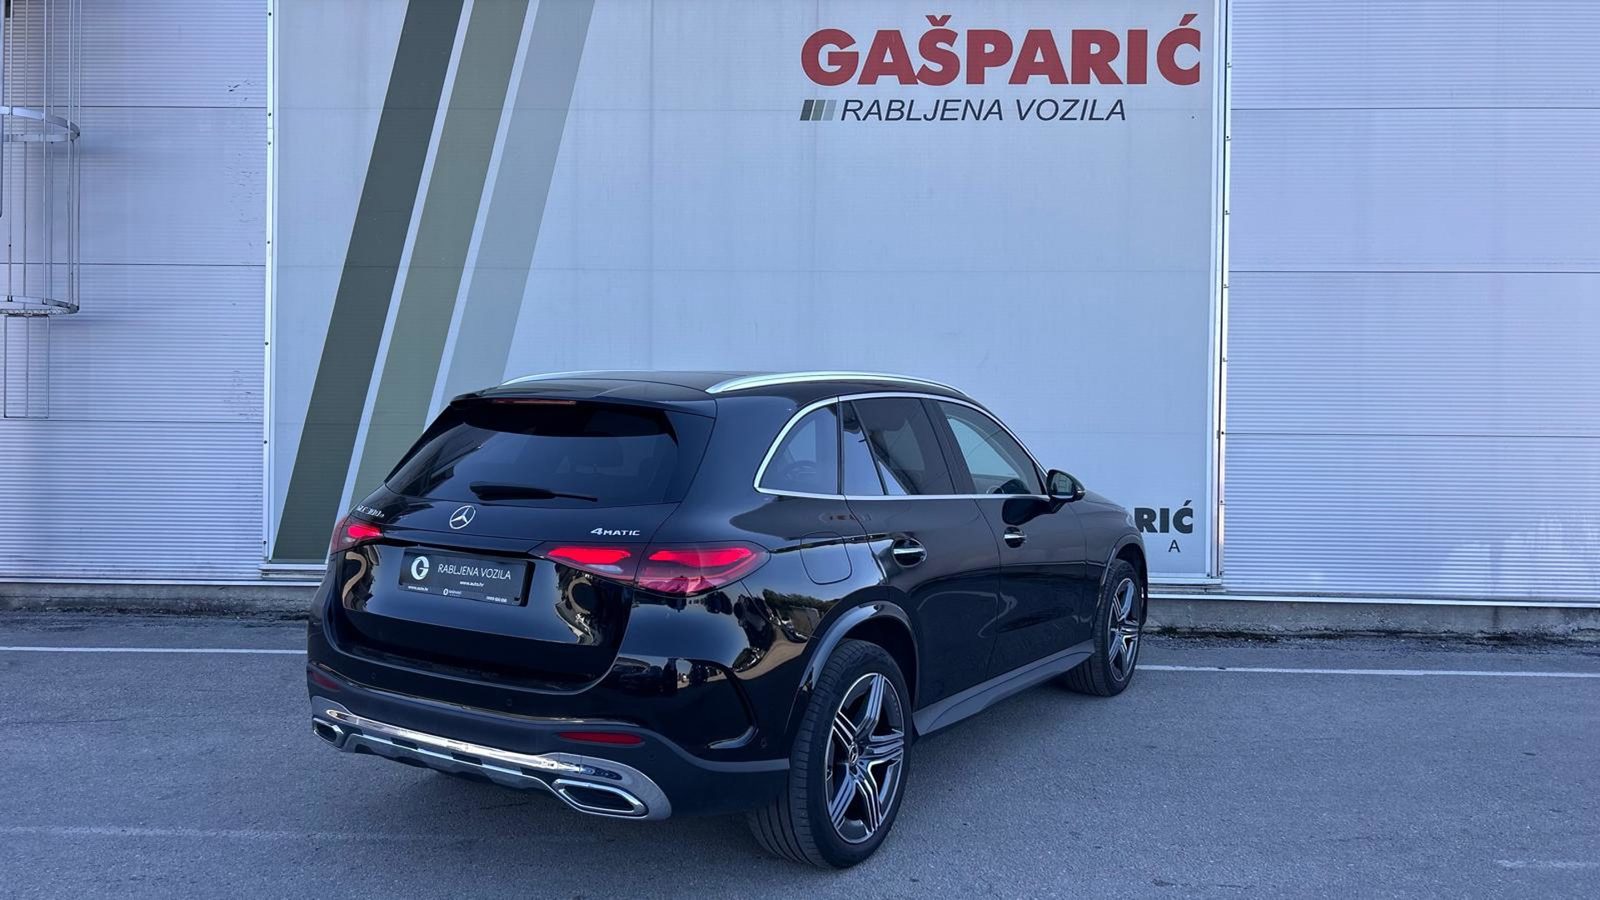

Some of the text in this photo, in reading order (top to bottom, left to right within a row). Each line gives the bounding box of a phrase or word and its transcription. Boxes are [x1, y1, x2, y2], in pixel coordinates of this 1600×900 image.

[801, 13, 1201, 86] GAŠPARIĆ
[841, 99, 1126, 121] RABLJENA VOZILA
[1134, 499, 1194, 534] RIĆ
[590, 527, 640, 536] 4MATIC
[1168, 539, 1181, 553] A
[438, 563, 512, 580] RABLJENA VOZILA
